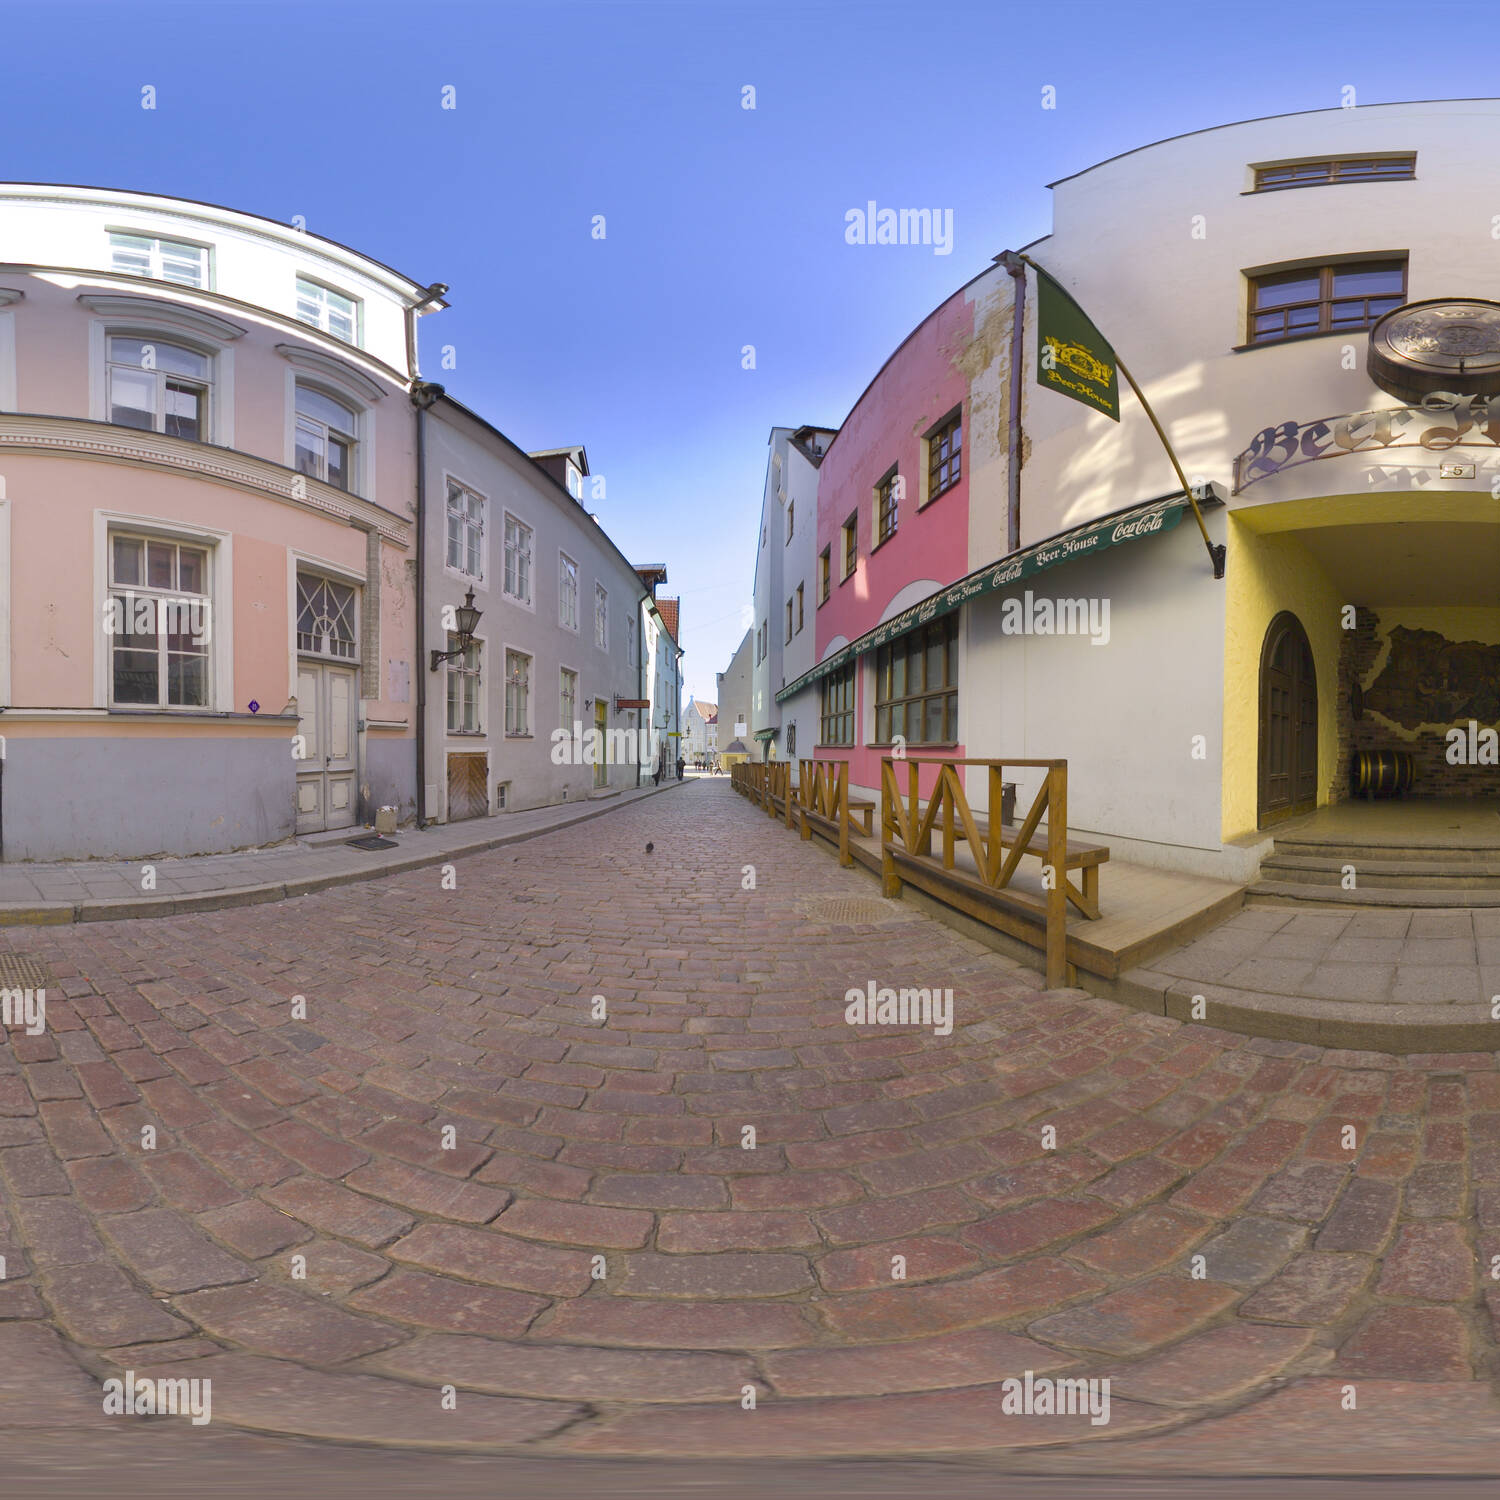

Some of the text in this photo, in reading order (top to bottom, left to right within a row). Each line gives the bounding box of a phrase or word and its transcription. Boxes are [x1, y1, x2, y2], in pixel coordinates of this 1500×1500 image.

[1245, 410, 1414, 481] Beer
[1452, 466, 1463, 476] 5
[1036, 550, 1060, 566] Beer
[1061, 535, 1099, 558] House
